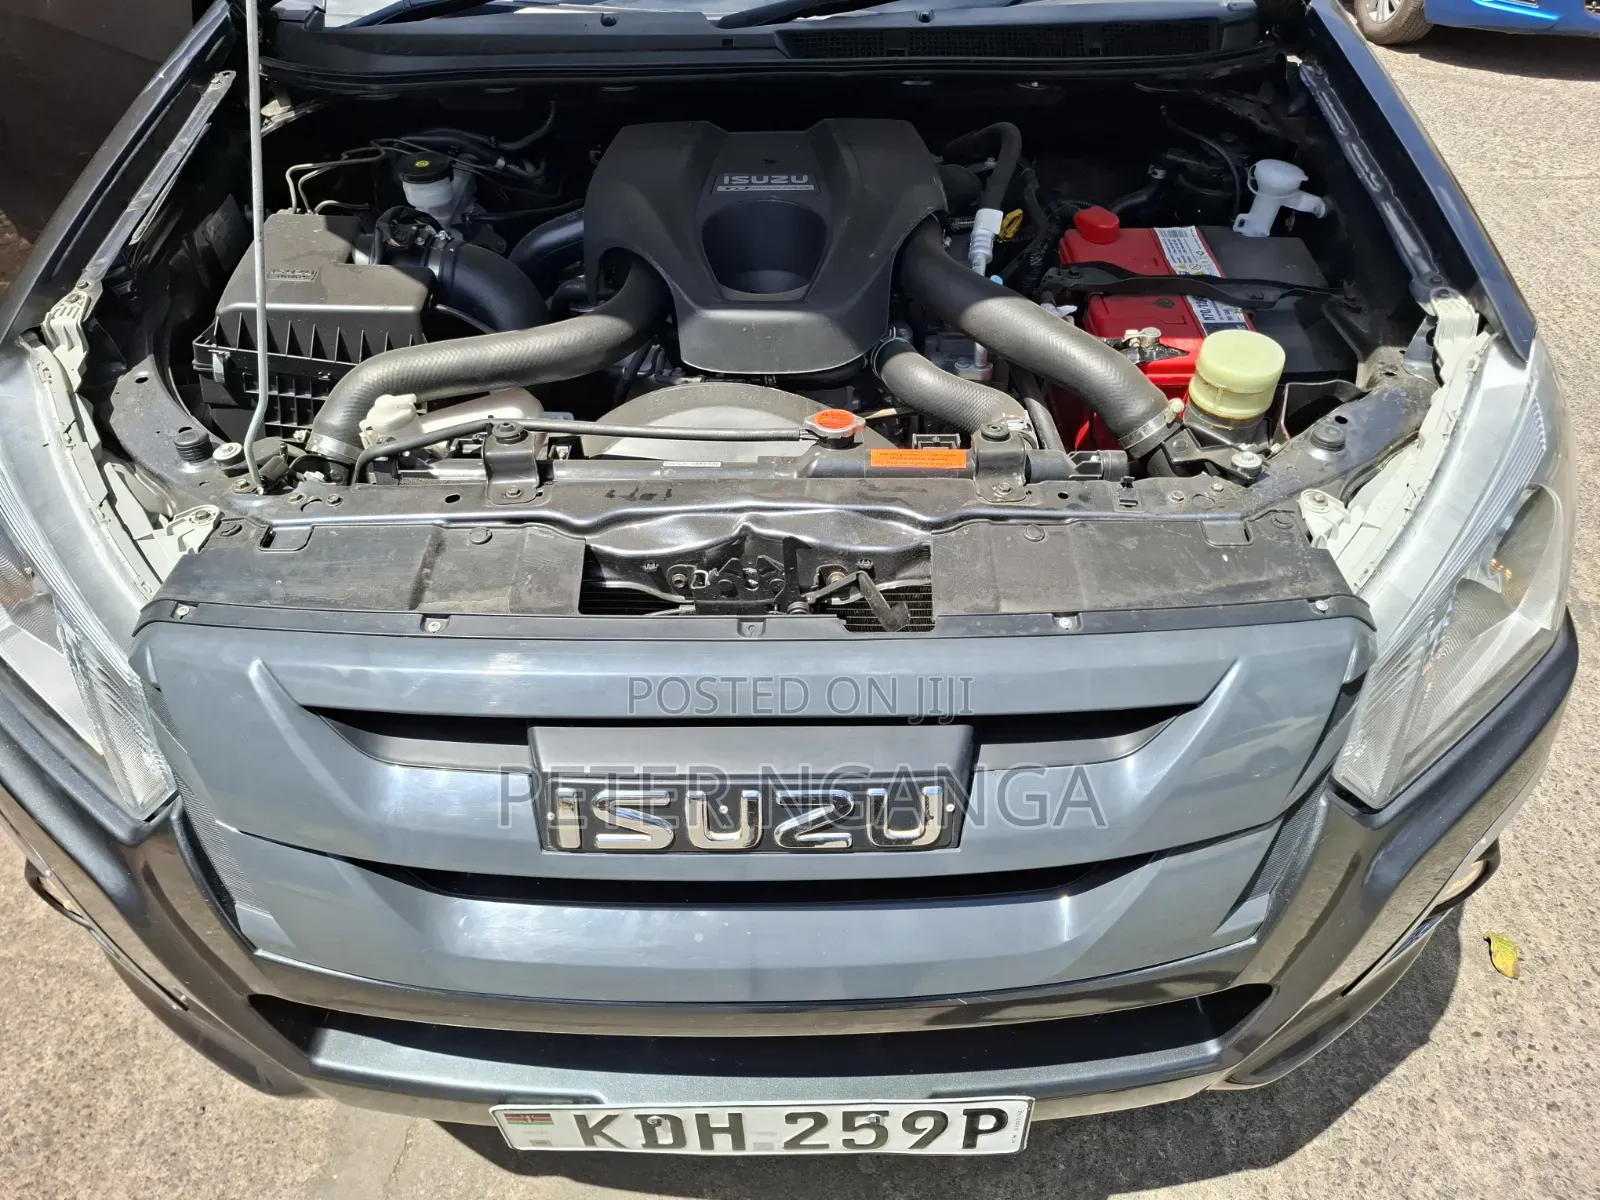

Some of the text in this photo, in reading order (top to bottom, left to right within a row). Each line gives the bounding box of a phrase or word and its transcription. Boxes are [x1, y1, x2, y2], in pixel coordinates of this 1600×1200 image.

[723, 175, 809, 184] ISUZU
[555, 786, 944, 849] ISUZU
[573, 1113, 747, 1151] KDH
[782, 1107, 1009, 1150] 259P
